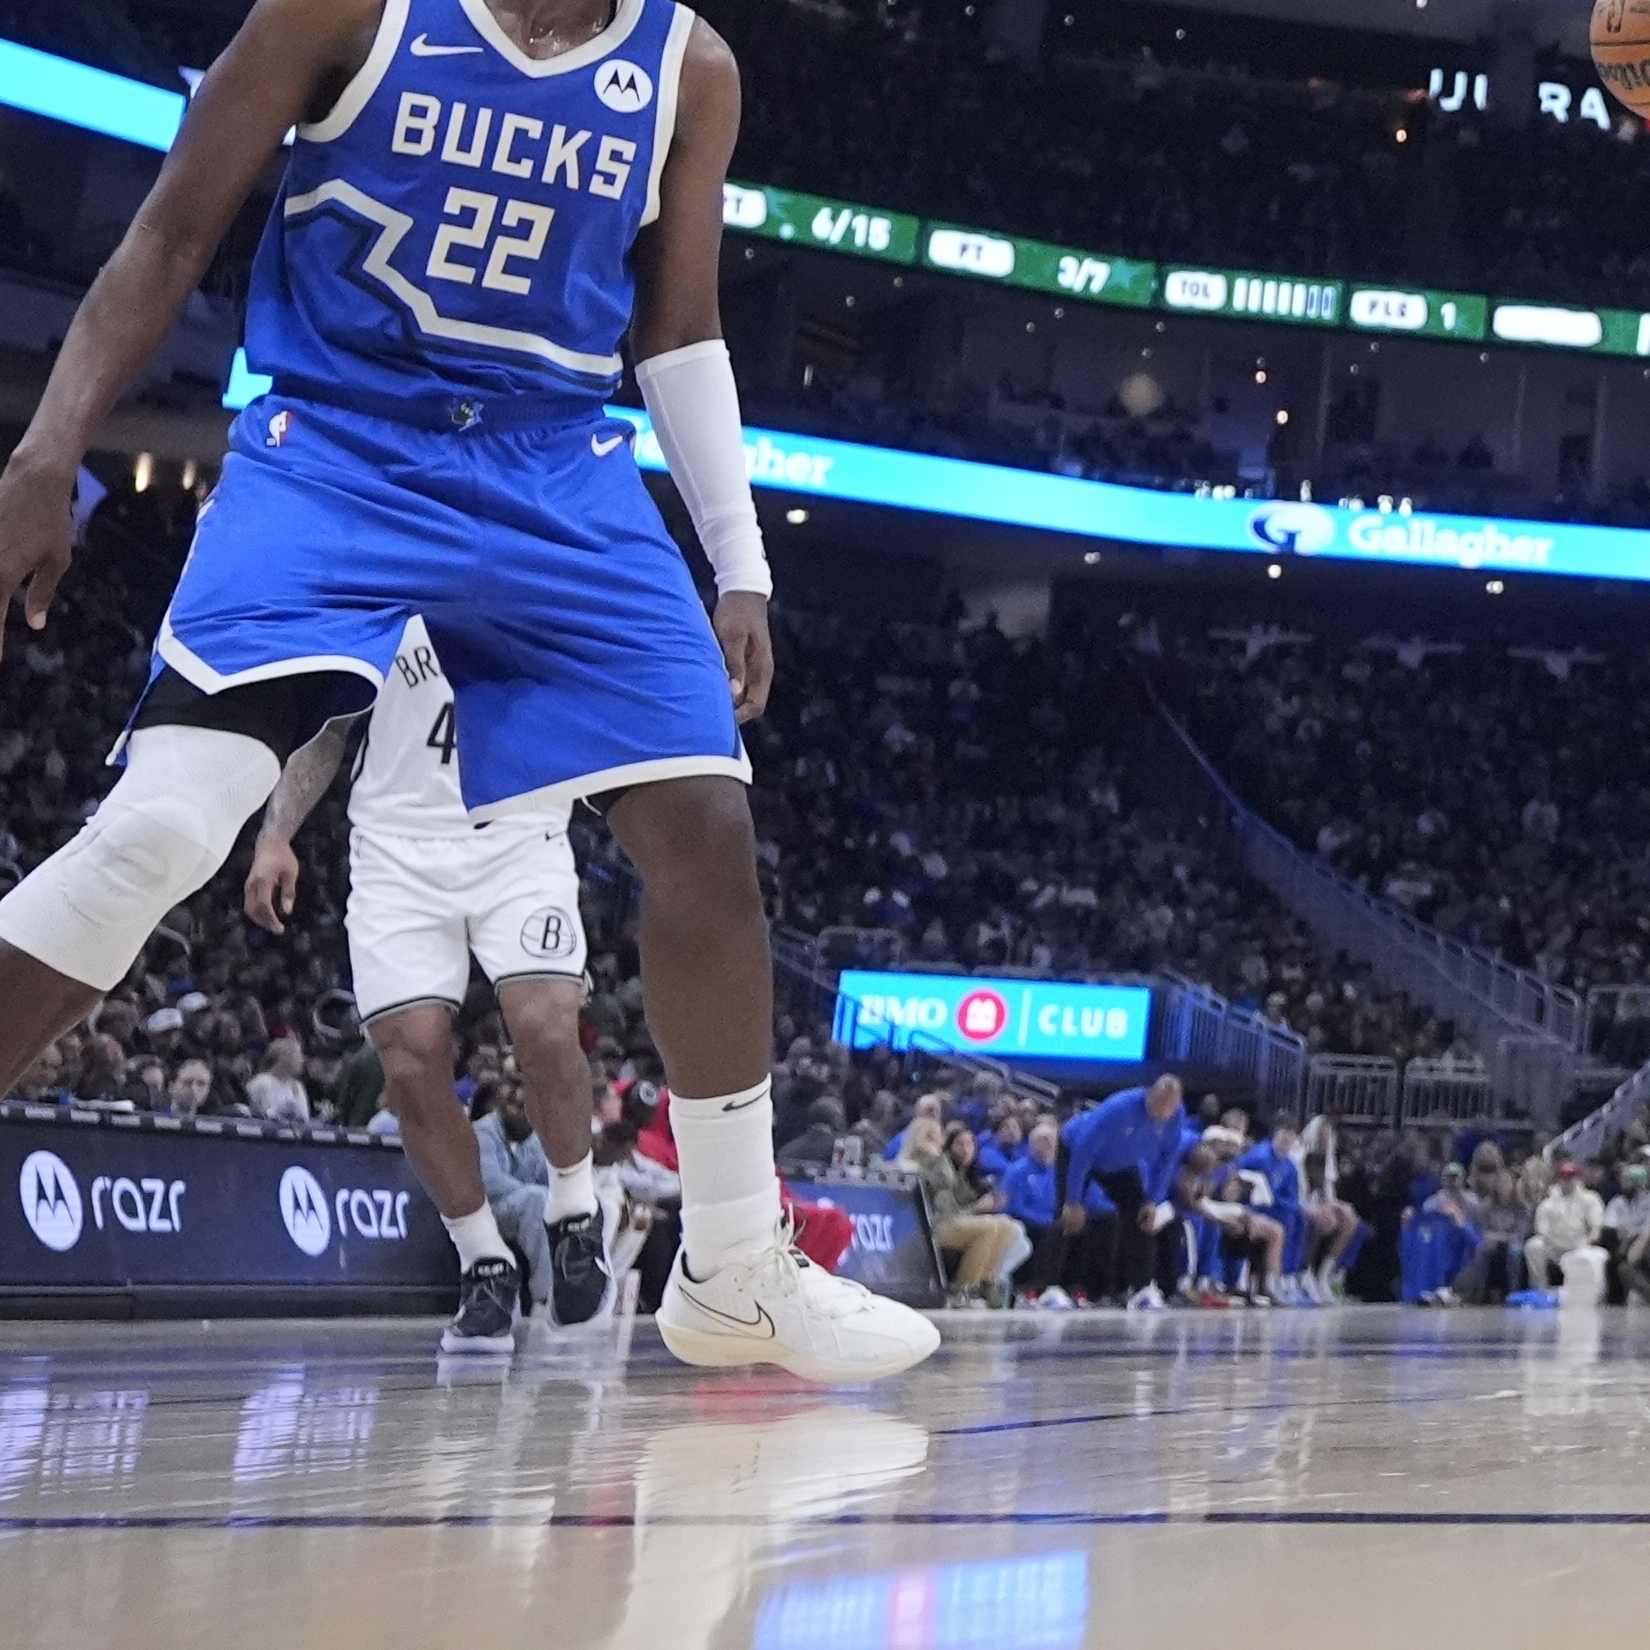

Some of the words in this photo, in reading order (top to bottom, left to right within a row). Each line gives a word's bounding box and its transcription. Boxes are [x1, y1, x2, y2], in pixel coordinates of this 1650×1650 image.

[391, 91, 638, 202] BUCKS
[425, 188, 555, 298] 22
[811, 206, 892, 251] 6/15
[1056, 254, 1111, 294] 3/7
[1440, 301, 1457, 331] 1
[1347, 513, 1555, 569] Gallagher
[540, 914, 562, 951] B
[1037, 1003, 1129, 1039] CLUB
[91, 1175, 187, 1233] razr
[335, 1188, 410, 1239] razr
